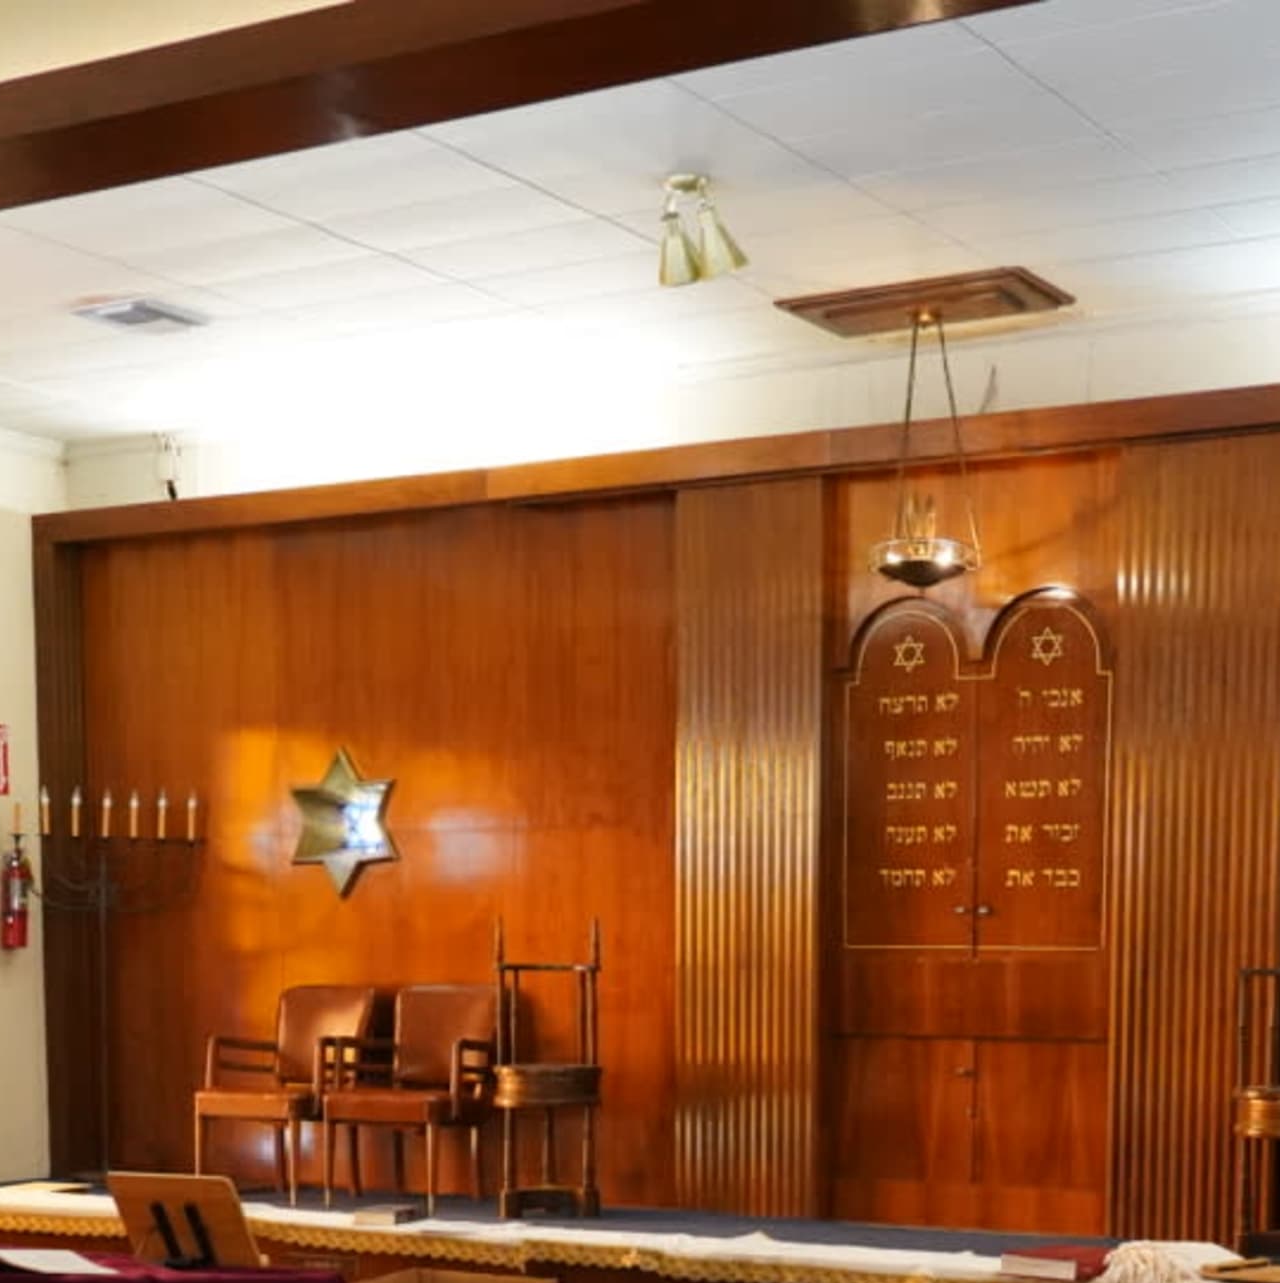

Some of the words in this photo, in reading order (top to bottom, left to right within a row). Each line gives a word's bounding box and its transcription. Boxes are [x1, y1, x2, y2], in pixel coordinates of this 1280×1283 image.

[935, 692, 960, 712] לא
[933, 737, 958, 756] לא
[1058, 734, 1083, 753] לא
[933, 781, 957, 800] לא
[1058, 778, 1082, 797] לא
[933, 824, 957, 843] לא
[1005, 824, 1032, 843] את
[932, 867, 957, 886] לא
[1006, 869, 1035, 887] את
[1042, 868, 1080, 887] כבד
